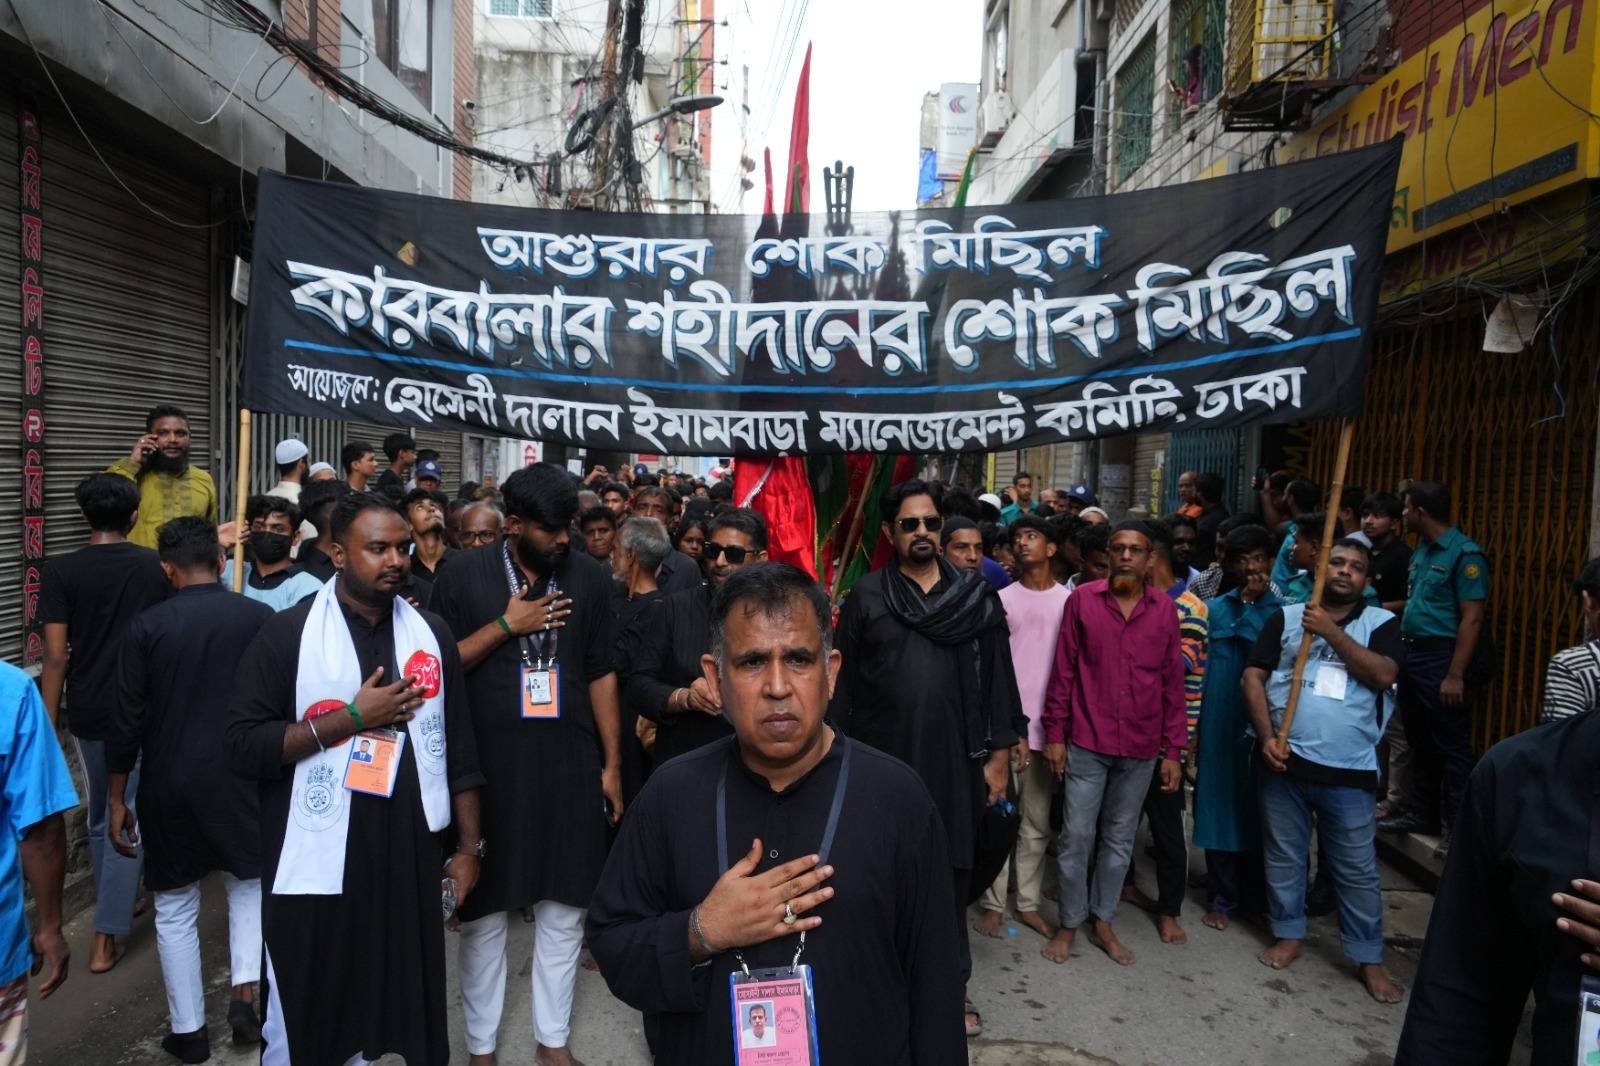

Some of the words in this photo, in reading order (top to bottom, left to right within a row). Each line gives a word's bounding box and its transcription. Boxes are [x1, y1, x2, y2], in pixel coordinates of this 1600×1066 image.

[1447, 0, 1585, 117] Men
[477, 226, 712, 285] আশুরার
[745, 236, 885, 276] শোক
[903, 215, 1108, 283] মিছিল
[286, 260, 616, 369] কারবালার
[625, 280, 931, 376] শহীদানের
[944, 287, 1129, 373] শোক
[1127, 244, 1357, 352] মিছিল
[384, 373, 499, 426] হোসেনী
[502, 392, 624, 440] দালান
[627, 386, 808, 455] ইমামবাড়া
[819, 390, 1028, 452] ম্যানেজমেন্ট
[1193, 366, 1307, 419] ঢাকা
